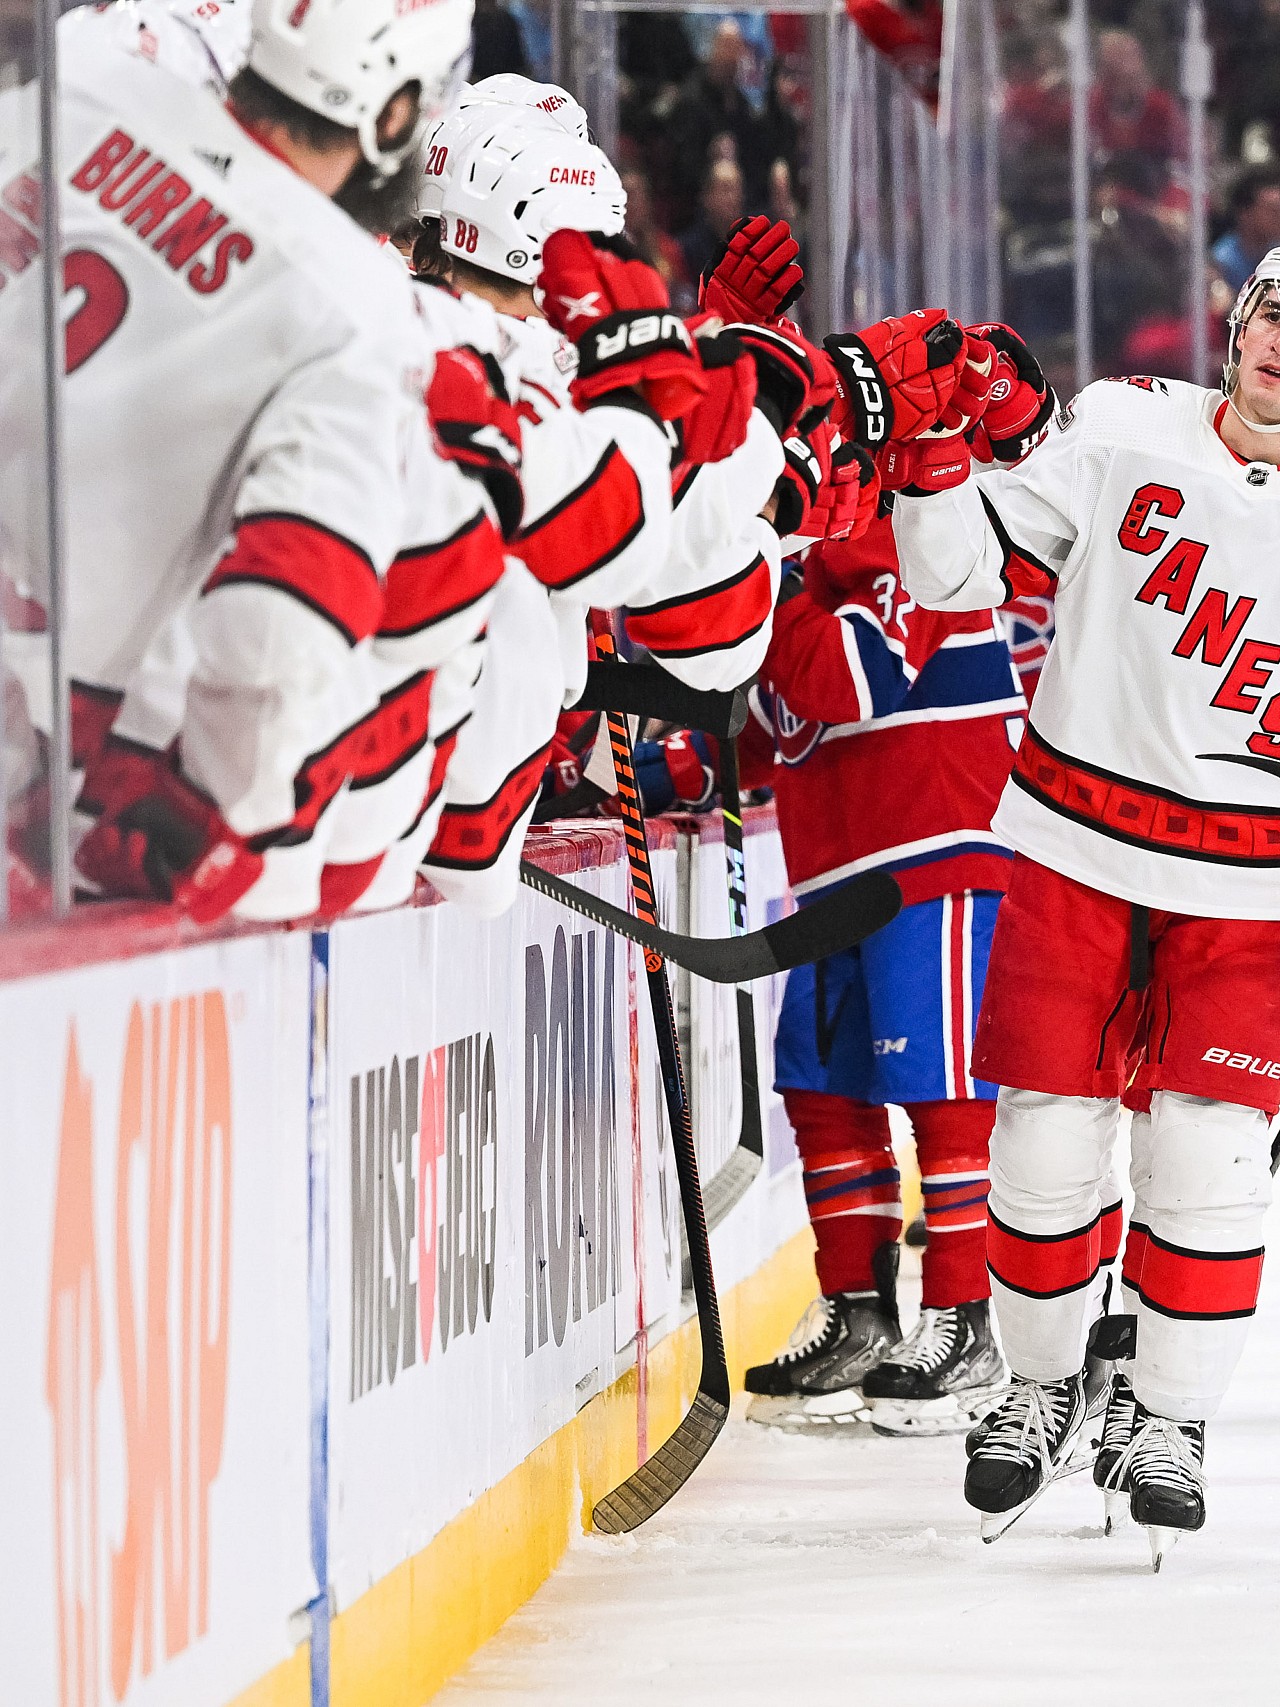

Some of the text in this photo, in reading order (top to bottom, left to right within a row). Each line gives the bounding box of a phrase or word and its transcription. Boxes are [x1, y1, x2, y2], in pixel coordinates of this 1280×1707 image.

[425, 145, 448, 176] 20
[550, 167, 596, 186] CANES
[69, 128, 254, 294] BURNS
[455, 218, 478, 253] 88
[595, 313, 694, 361] UER
[838, 346, 885, 442] CCM
[931, 463, 964, 477] BAUER
[110, 989, 232, 1703] SKIP
